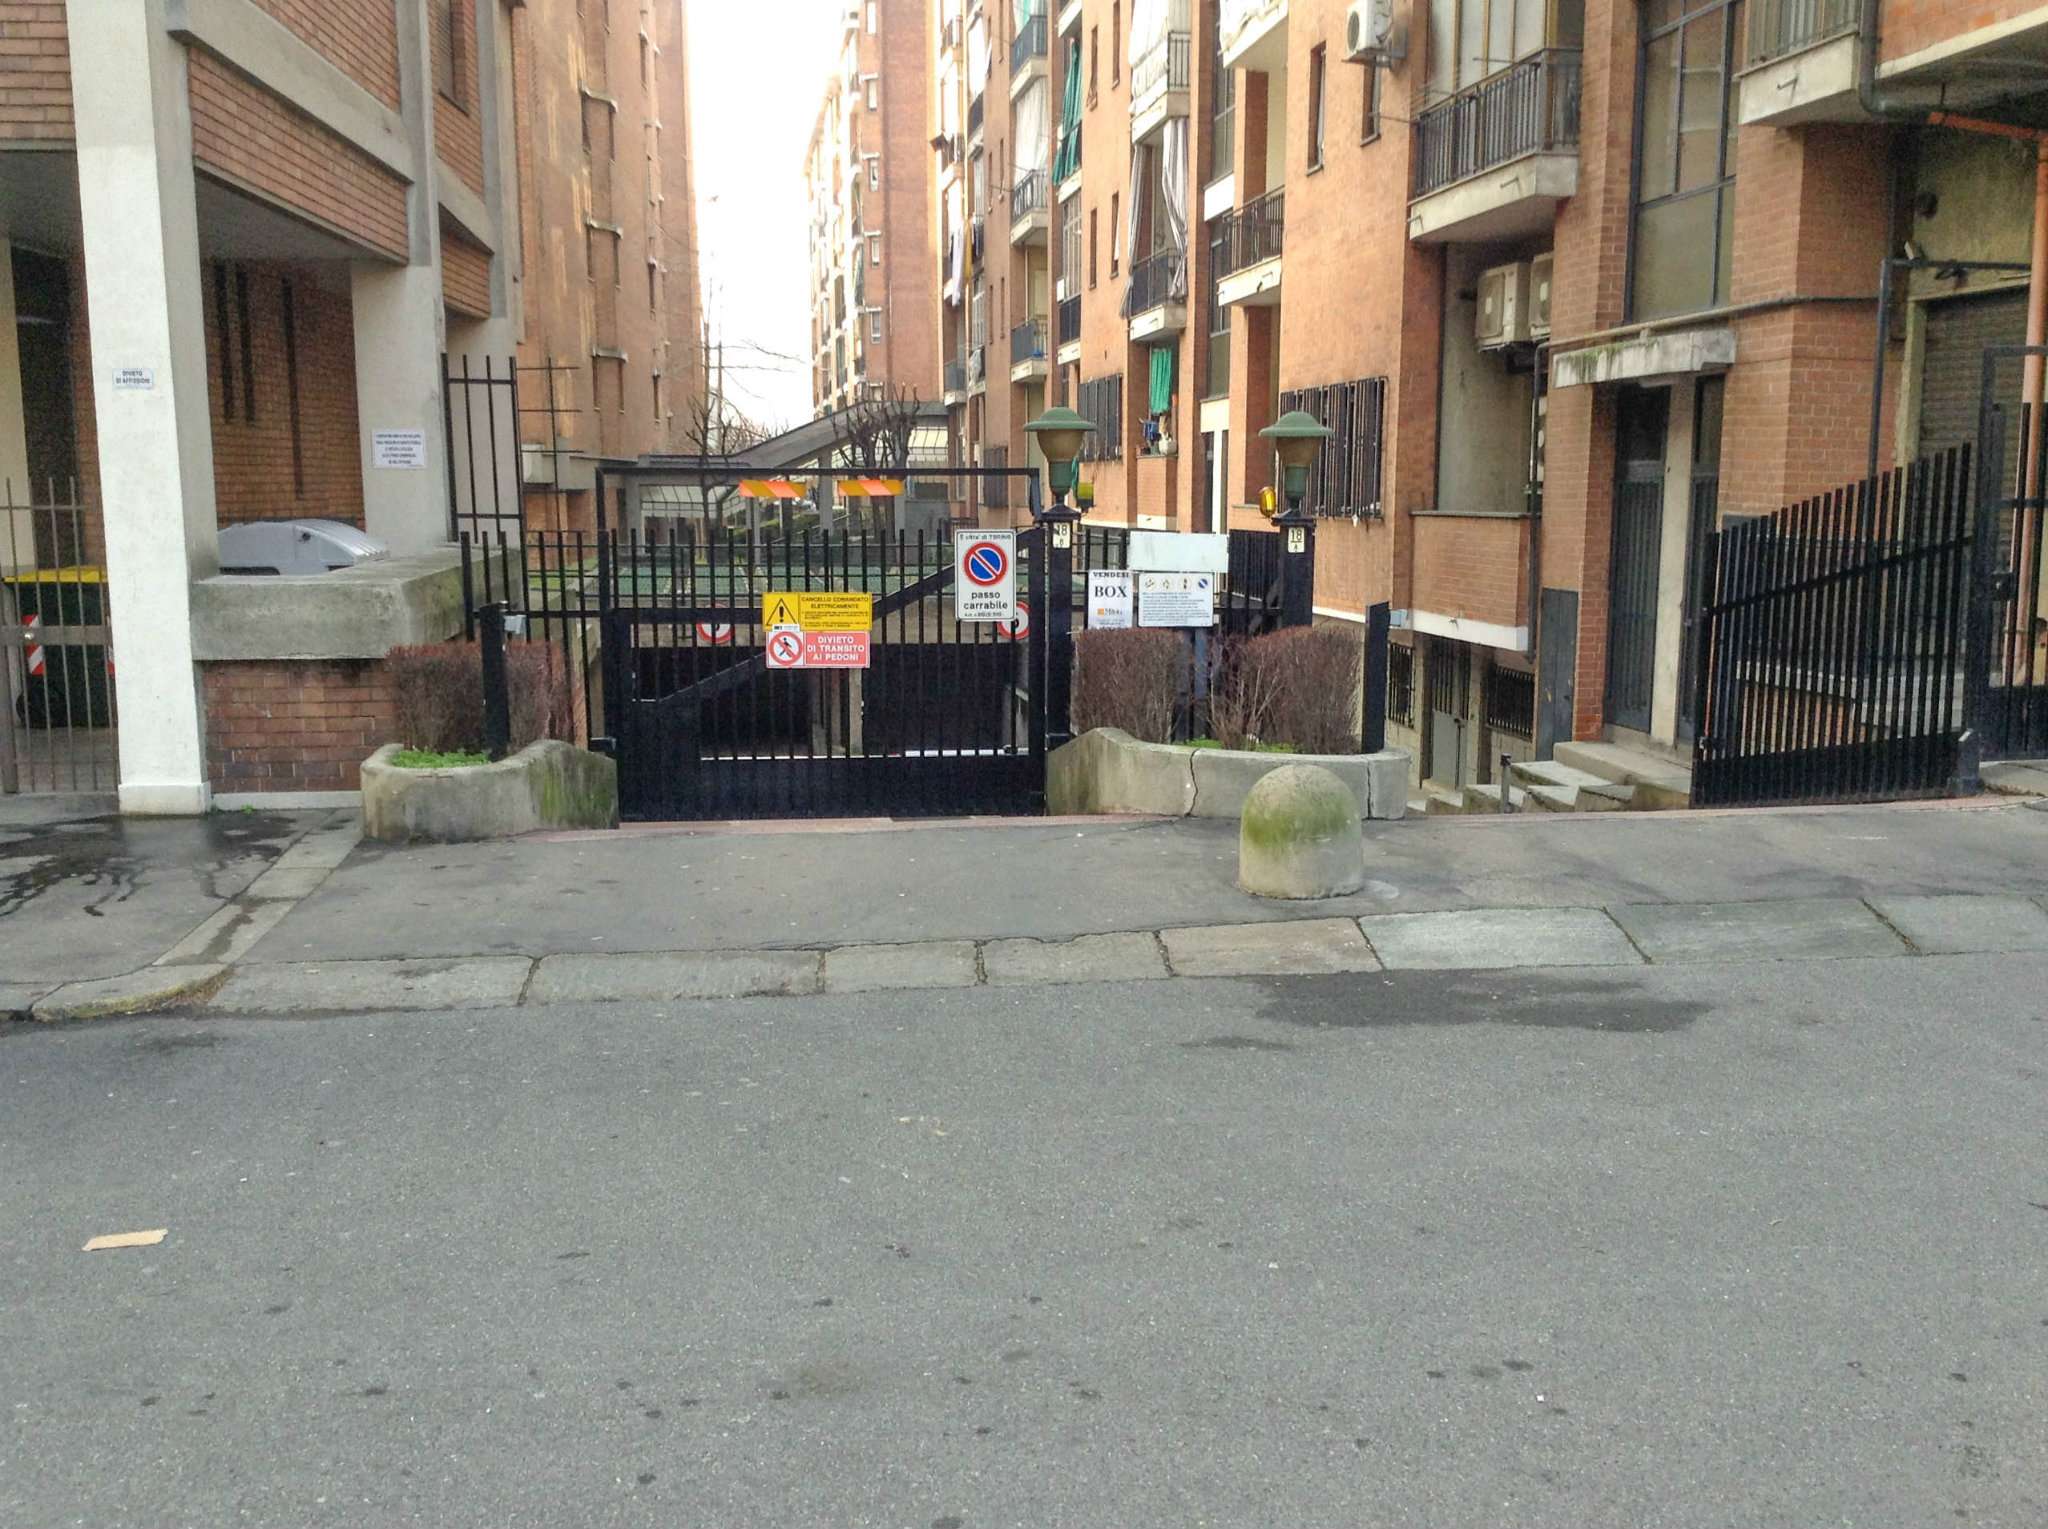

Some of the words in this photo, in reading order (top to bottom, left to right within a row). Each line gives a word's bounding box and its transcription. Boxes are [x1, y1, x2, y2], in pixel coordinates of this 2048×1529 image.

[1291, 527, 1302, 541] 18
[971, 591, 1001, 600] passo
[1094, 586, 1128, 598] BOX
[963, 600, 1008, 610] carrabile
[817, 636, 854, 644] DIVIETO
[807, 644, 816, 652] DI
[819, 644, 865, 652] TRANSITO
[812, 653, 822, 661] AI
[825, 653, 859, 661] PEDONI
